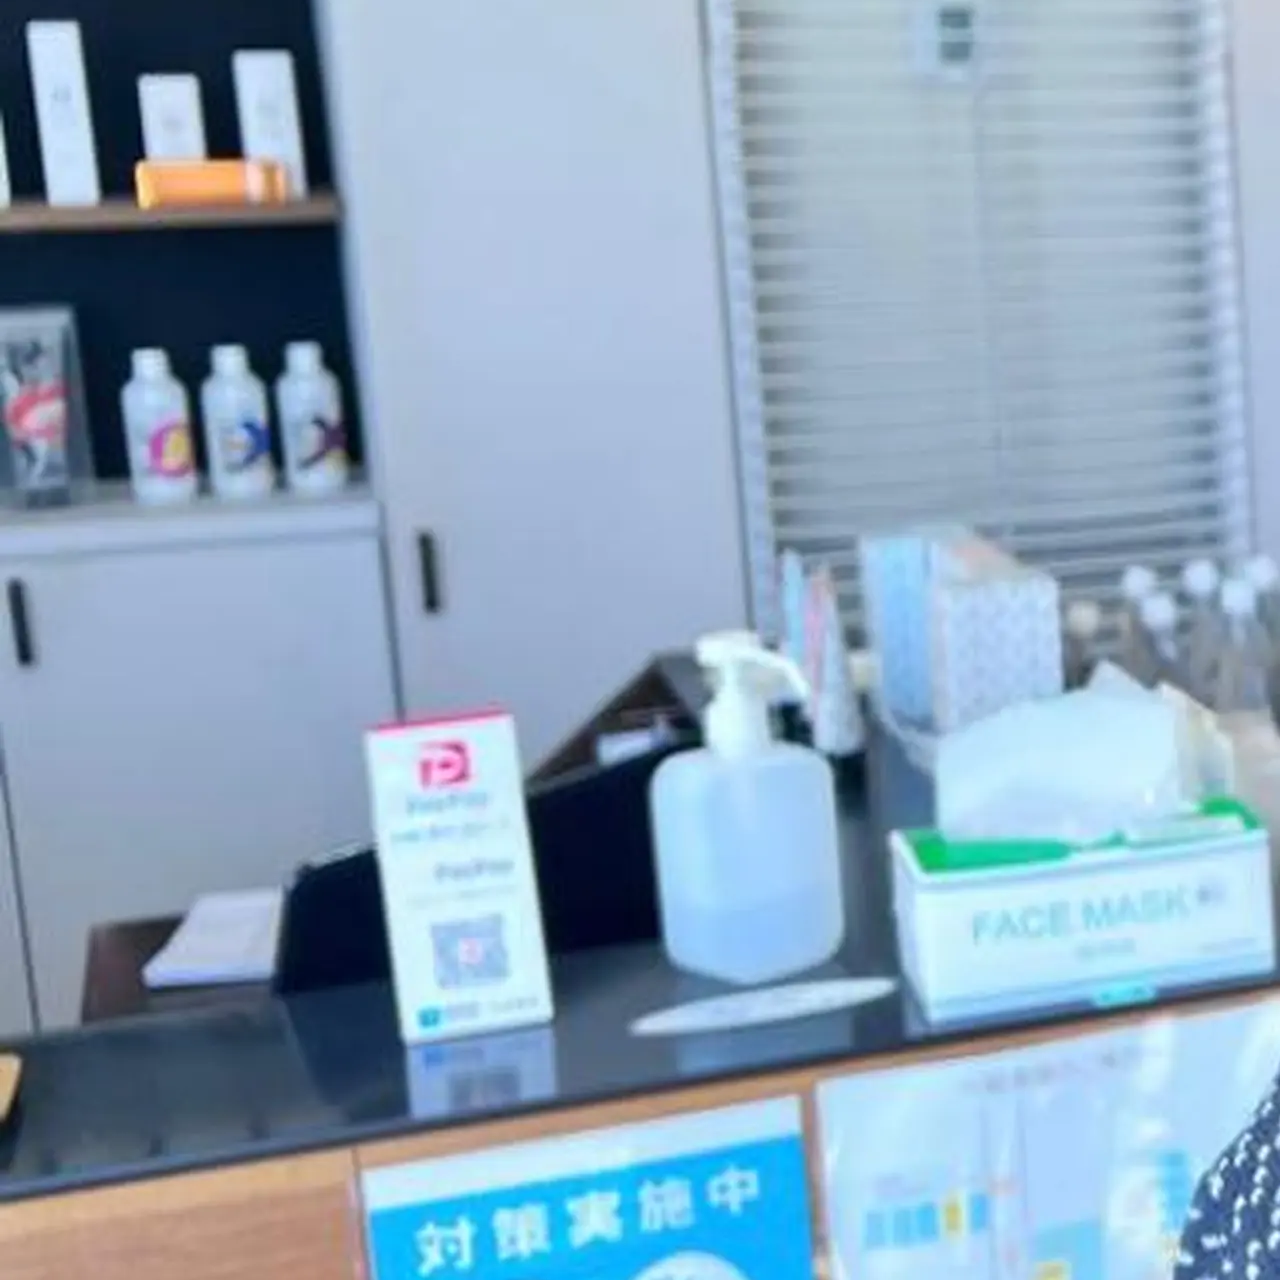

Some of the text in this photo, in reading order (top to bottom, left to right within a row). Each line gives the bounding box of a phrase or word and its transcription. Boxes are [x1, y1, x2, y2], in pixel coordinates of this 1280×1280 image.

[973, 884, 1190, 946] FACE MASK
[415, 1164, 761, 1276] 対策実施中
